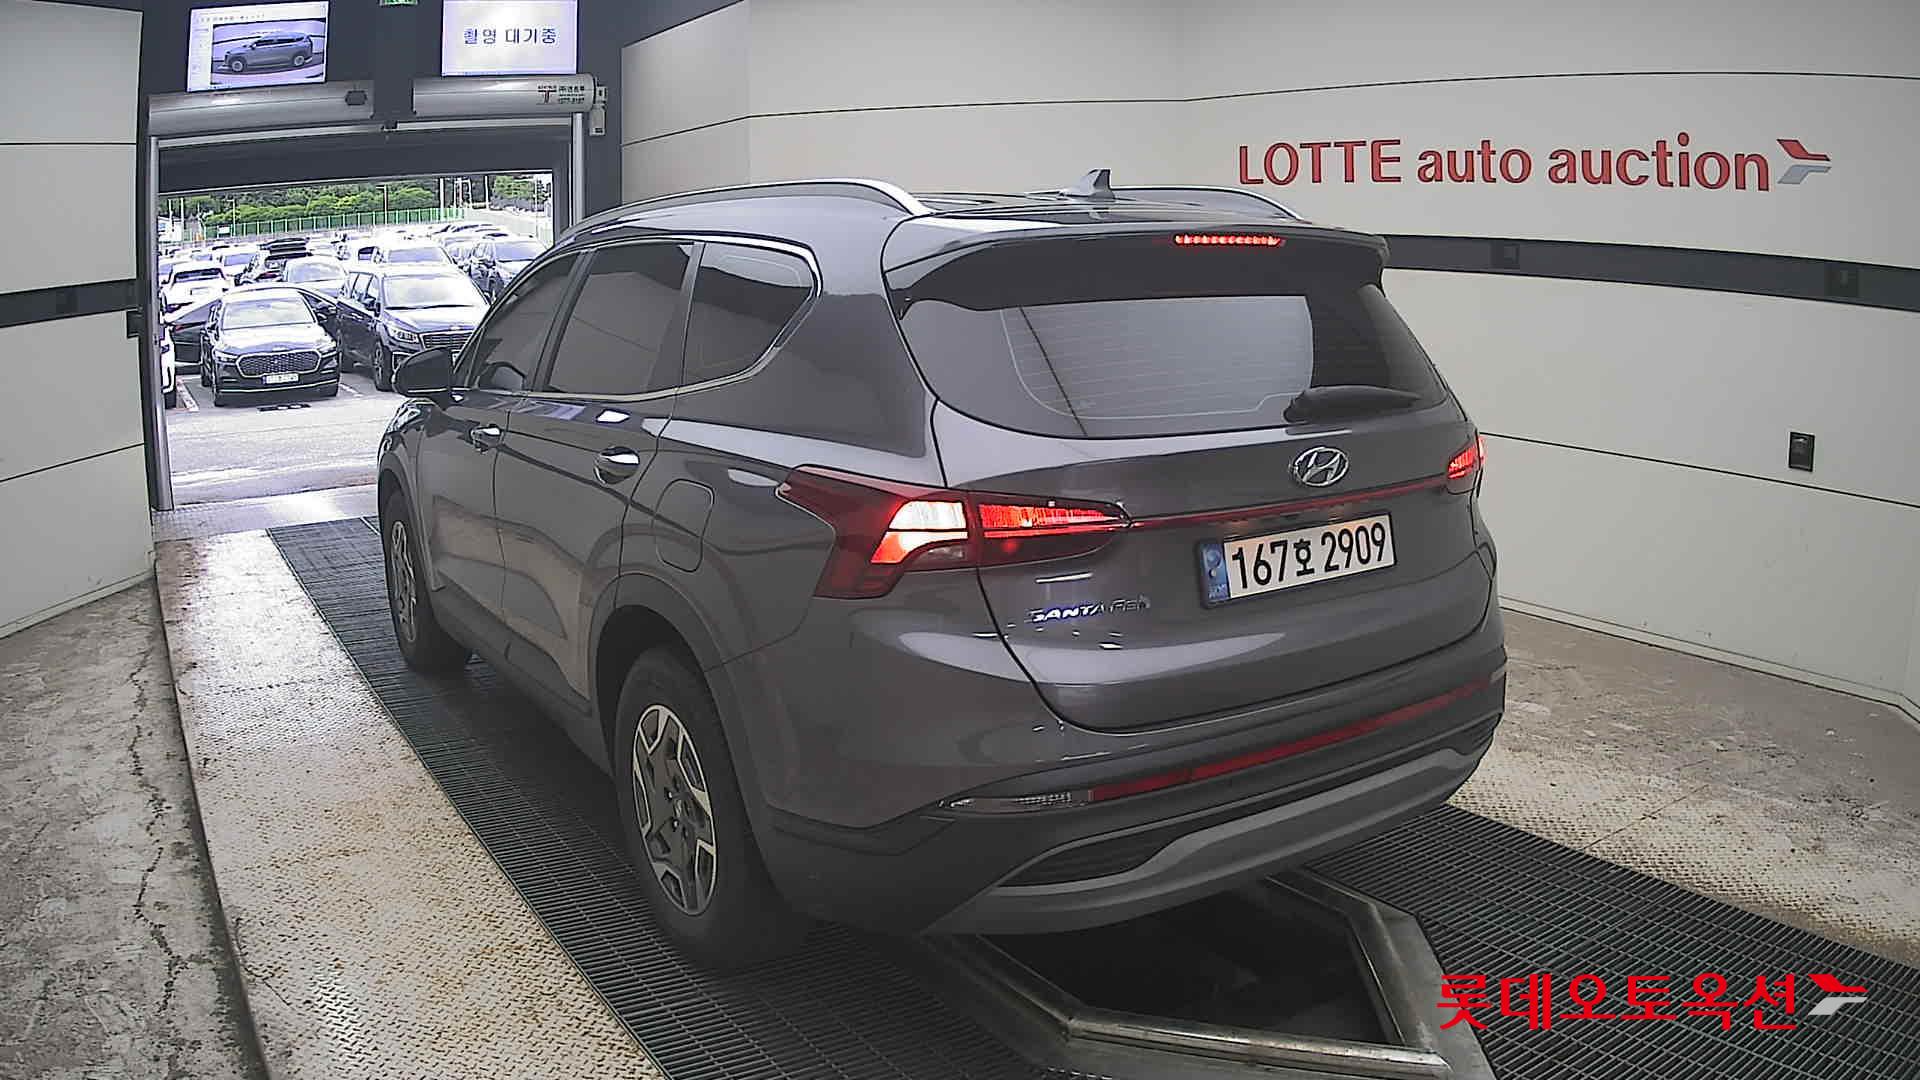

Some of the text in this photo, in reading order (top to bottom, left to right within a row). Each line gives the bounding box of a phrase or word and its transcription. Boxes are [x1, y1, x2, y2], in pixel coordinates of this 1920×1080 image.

[505, 28, 557, 44] 대기중
[1239, 132, 1769, 191] LOTTE auto auction
[1232, 522, 1386, 589] 167호 2909
[1030, 602, 1105, 623] SANTA
